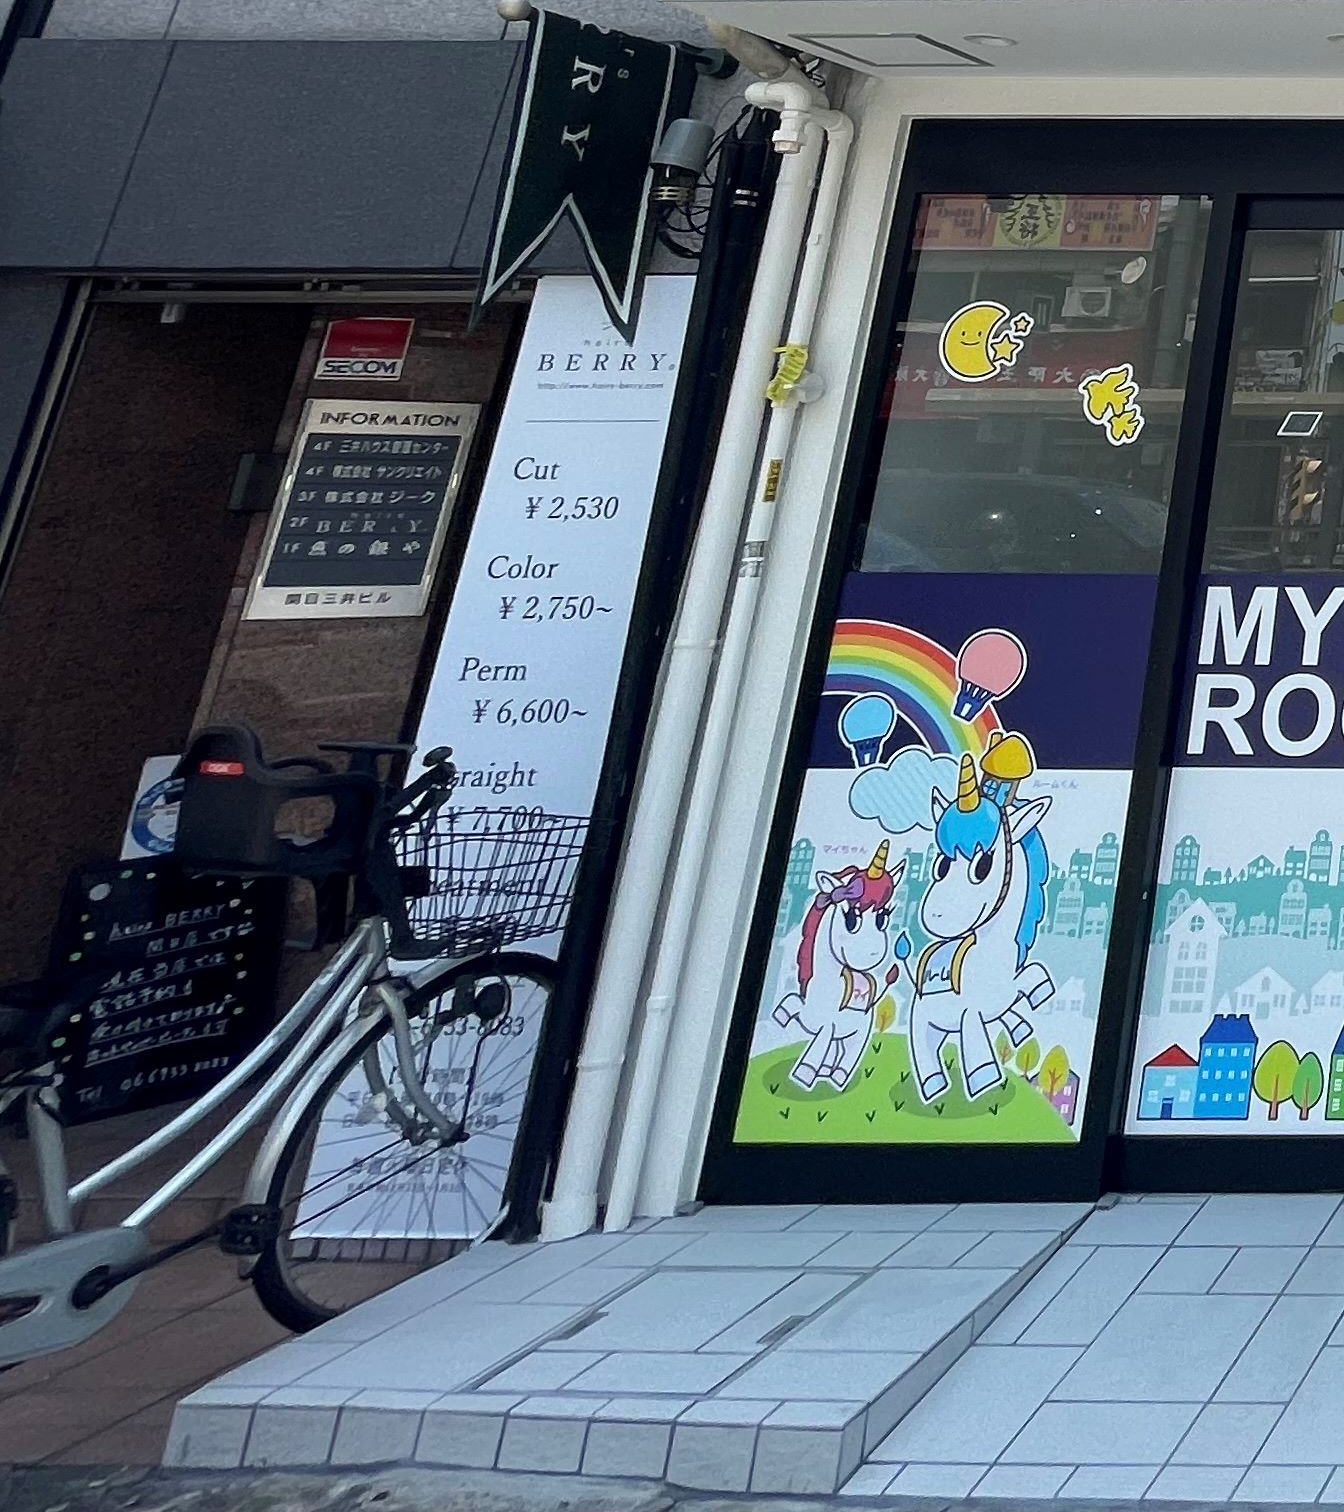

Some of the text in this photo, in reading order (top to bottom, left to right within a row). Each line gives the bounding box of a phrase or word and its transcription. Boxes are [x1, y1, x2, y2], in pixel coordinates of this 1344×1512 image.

[321, 360, 398, 375] SECOM
[320, 411, 460, 428] INFORMATION
[513, 456, 561, 481] Cut
[487, 555, 560, 581] Color
[458, 657, 528, 683] Perm
[454, 761, 539, 795] raight
